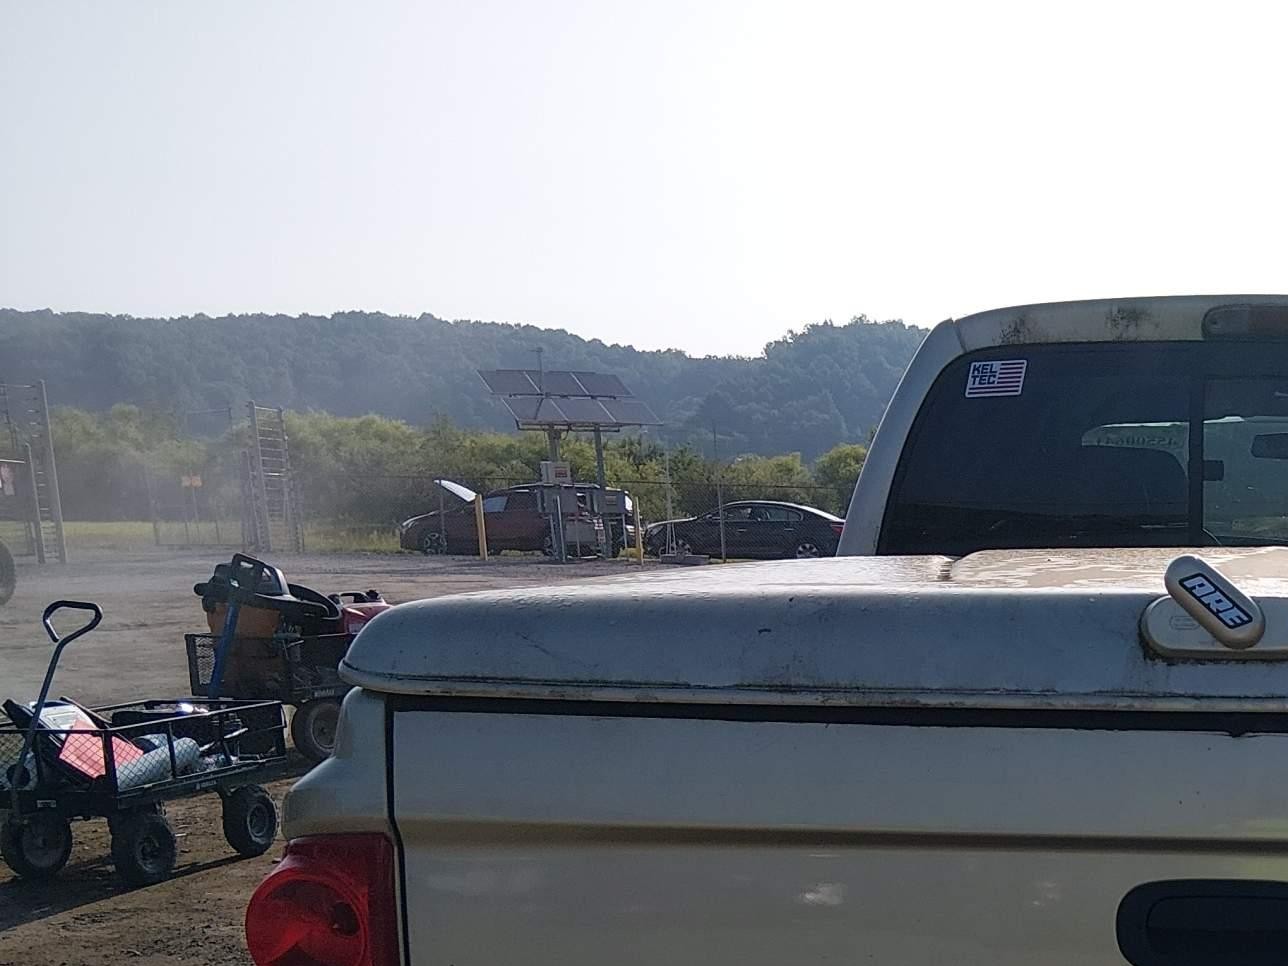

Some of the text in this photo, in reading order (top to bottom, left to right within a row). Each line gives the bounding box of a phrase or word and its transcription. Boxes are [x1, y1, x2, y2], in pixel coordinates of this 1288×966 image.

[971, 363, 998, 375] KEL
[970, 374, 997, 386] TEC
[1182, 575, 1251, 628] ARE
